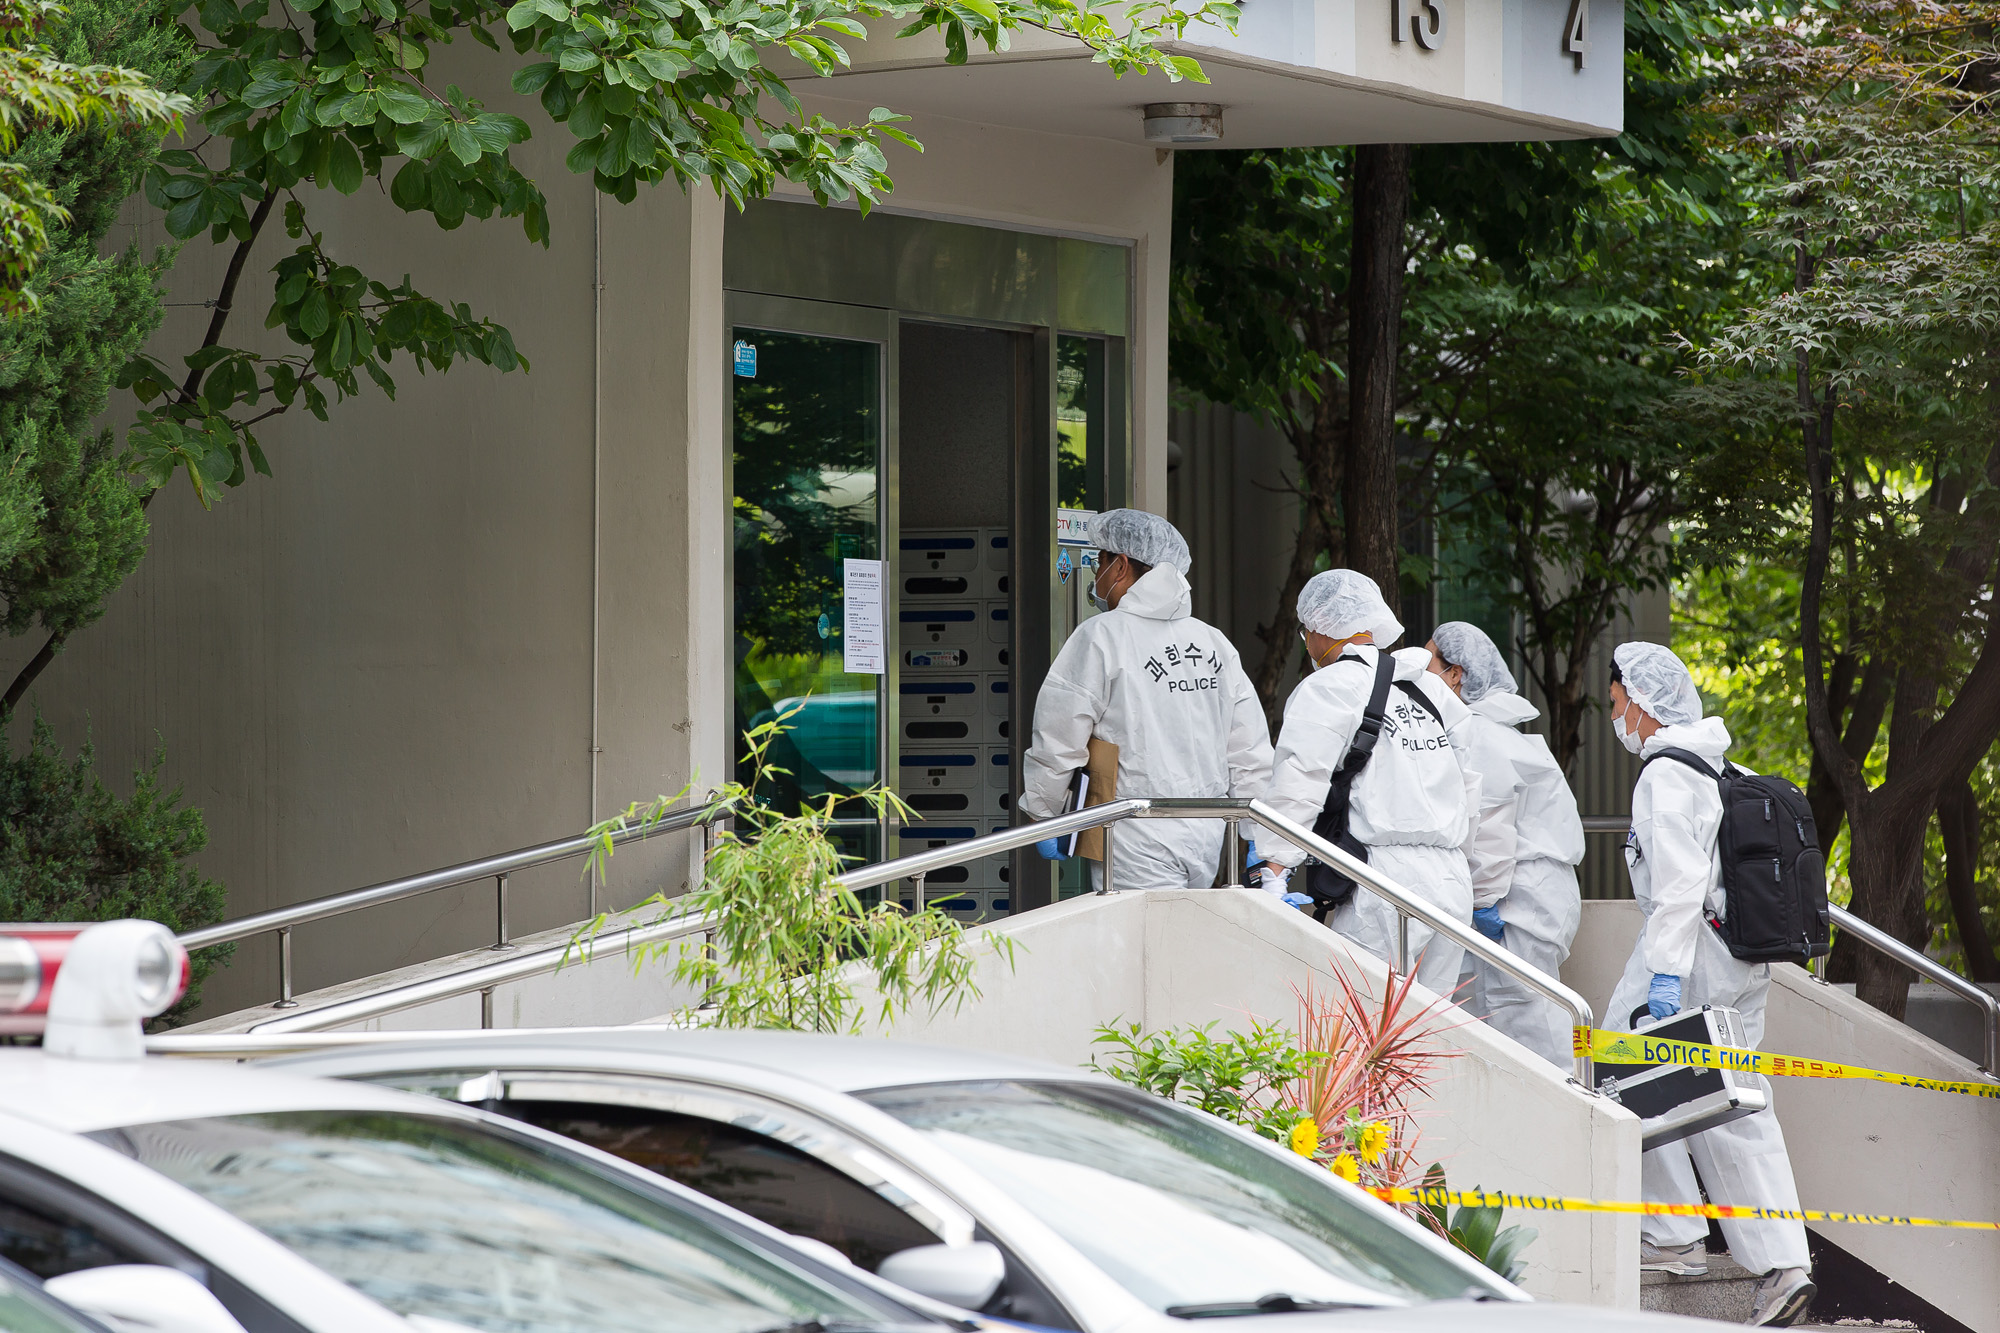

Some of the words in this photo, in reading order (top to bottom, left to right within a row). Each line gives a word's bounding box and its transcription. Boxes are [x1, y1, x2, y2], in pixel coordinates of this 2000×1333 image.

[1562, 0, 1593, 69] 4
[1168, 677, 1218, 693] POLICE
[1402, 735, 1449, 752] POLICE
